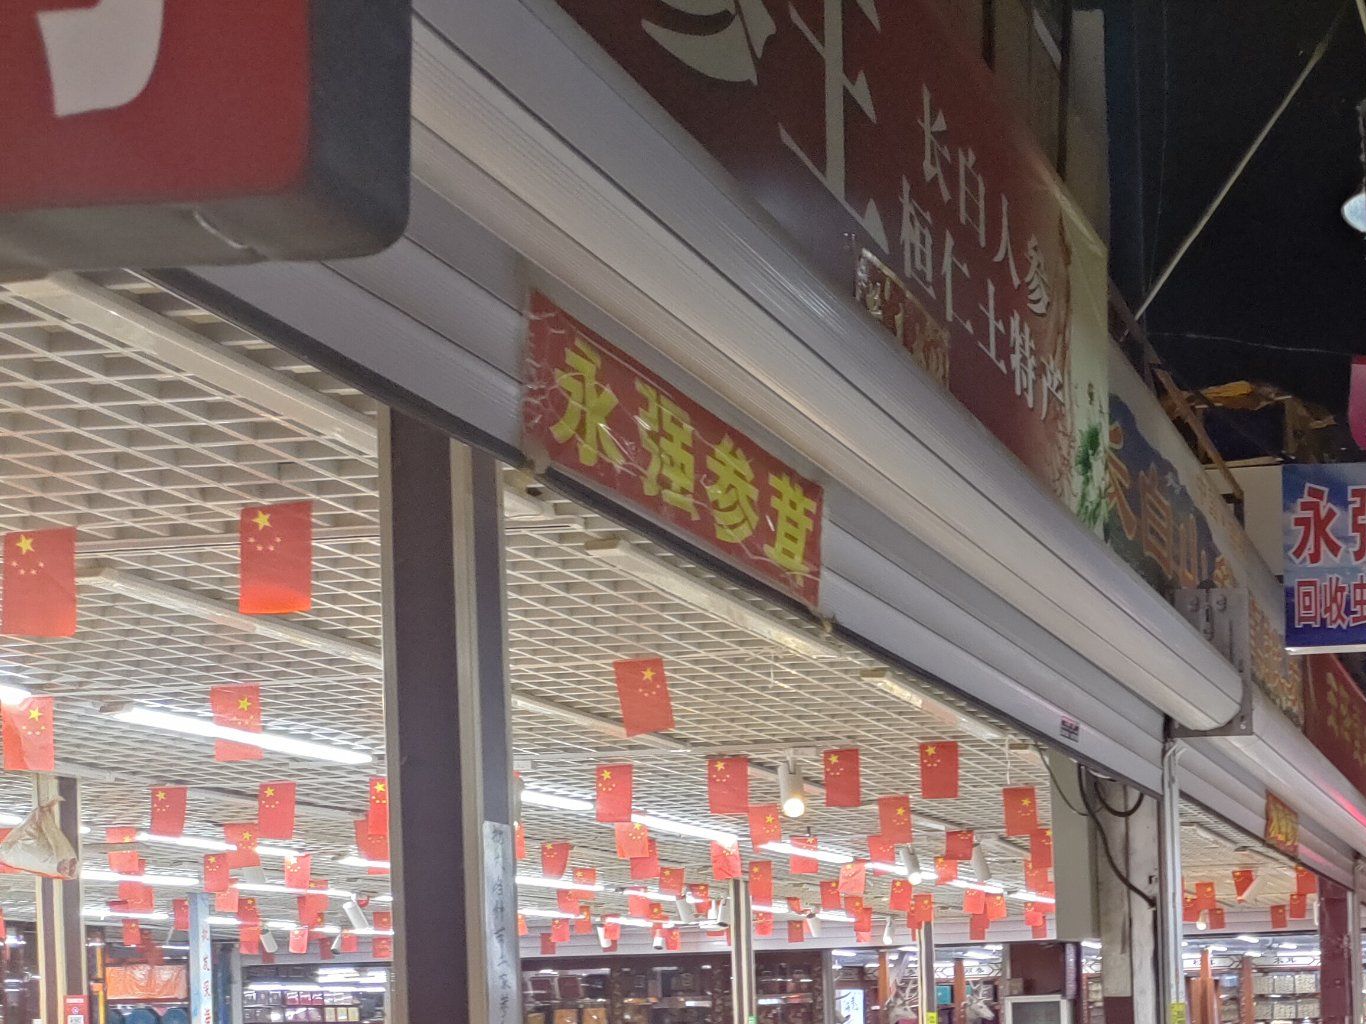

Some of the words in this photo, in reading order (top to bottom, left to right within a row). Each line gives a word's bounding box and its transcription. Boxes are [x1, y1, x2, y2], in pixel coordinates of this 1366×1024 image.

[899, 174, 1065, 421] 桓仁土特产
[917, 82, 1050, 316] 长白人参
[549, 333, 817, 586] 永强参茸
